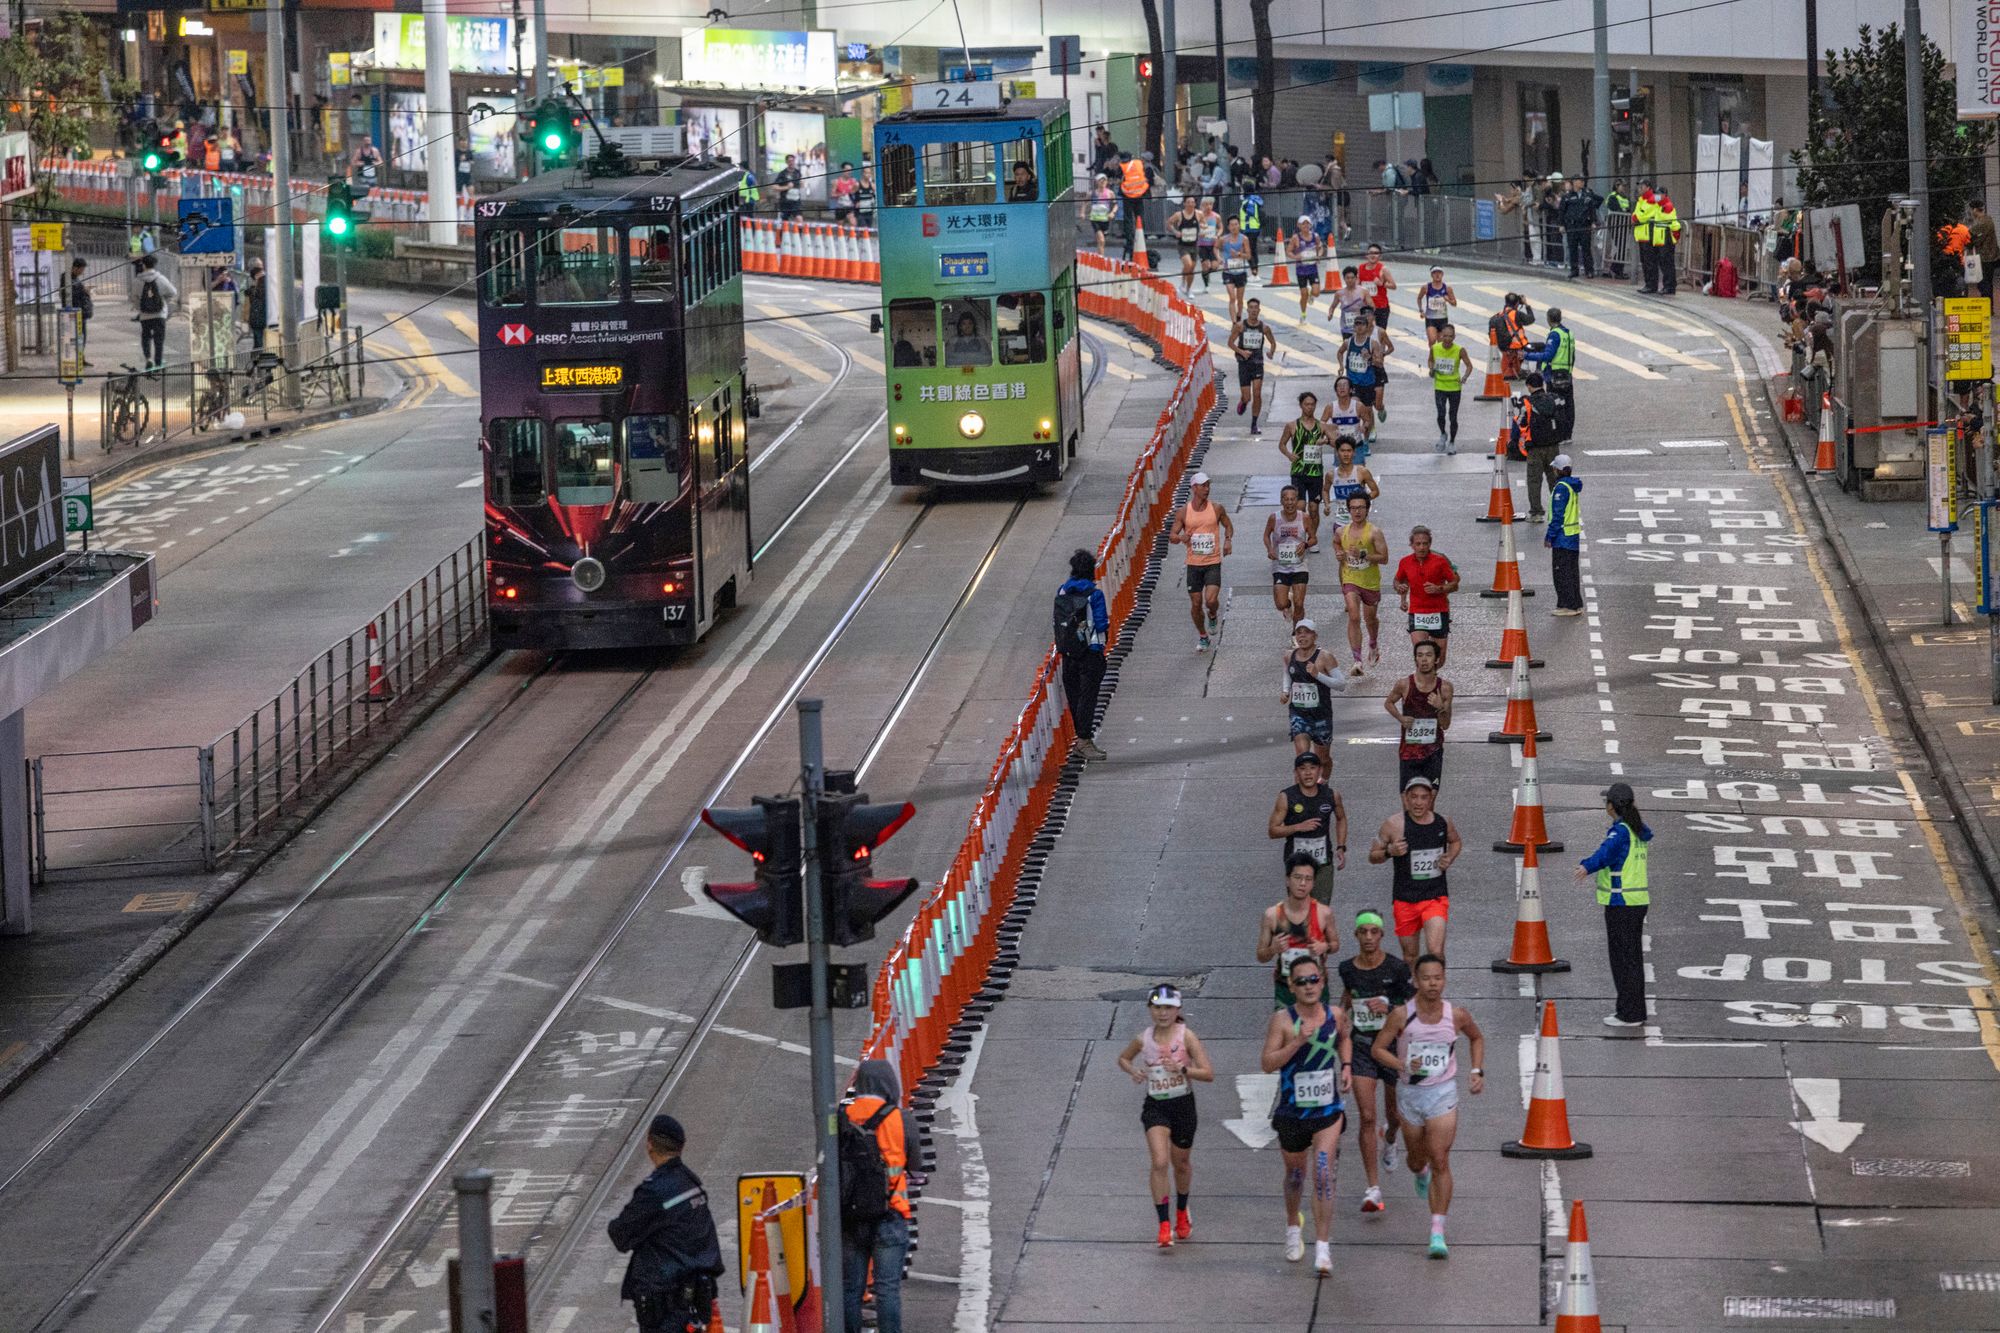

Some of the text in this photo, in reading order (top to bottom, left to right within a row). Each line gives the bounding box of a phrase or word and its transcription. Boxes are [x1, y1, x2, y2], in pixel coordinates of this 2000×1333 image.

[1976, 6, 1989, 104] WORLD CITY
[936, 88, 974, 108] 24
[885, 132, 900, 144] 24
[1020, 127, 1035, 138] 24
[651, 197, 675, 211] 137
[946, 213, 1008, 229] 光大環境
[536, 332, 663, 344] HSBC Asset Management
[541, 367, 622, 386] 上環(西港城)
[920, 382, 1027, 402] 共創綠色香港
[1036, 449, 1051, 461] 24
[155, 462, 300, 480] BUS
[117, 475, 290, 492] STOP
[1613, 509, 1785, 528] 巴士
[1596, 533, 1812, 547] STOP
[1626, 550, 1794, 565] BUS
[663, 605, 686, 620] 137
[1416, 616, 1440, 625] 54029
[1644, 615, 1822, 642] 巴士
[1628, 648, 1852, 669] STOP
[1651, 672, 1846, 694] BUS
[1407, 727, 1436, 738] 58324
[1666, 735, 1878, 771] 巴士
[1652, 780, 1911, 806] STOP
[1685, 813, 1906, 838] BUS
[1699, 898, 1954, 944] 巴士
[1677, 953, 1992, 987] STOP
[1724, 1000, 1982, 1032] BUS
[1298, 1082, 1332, 1098] 51090
